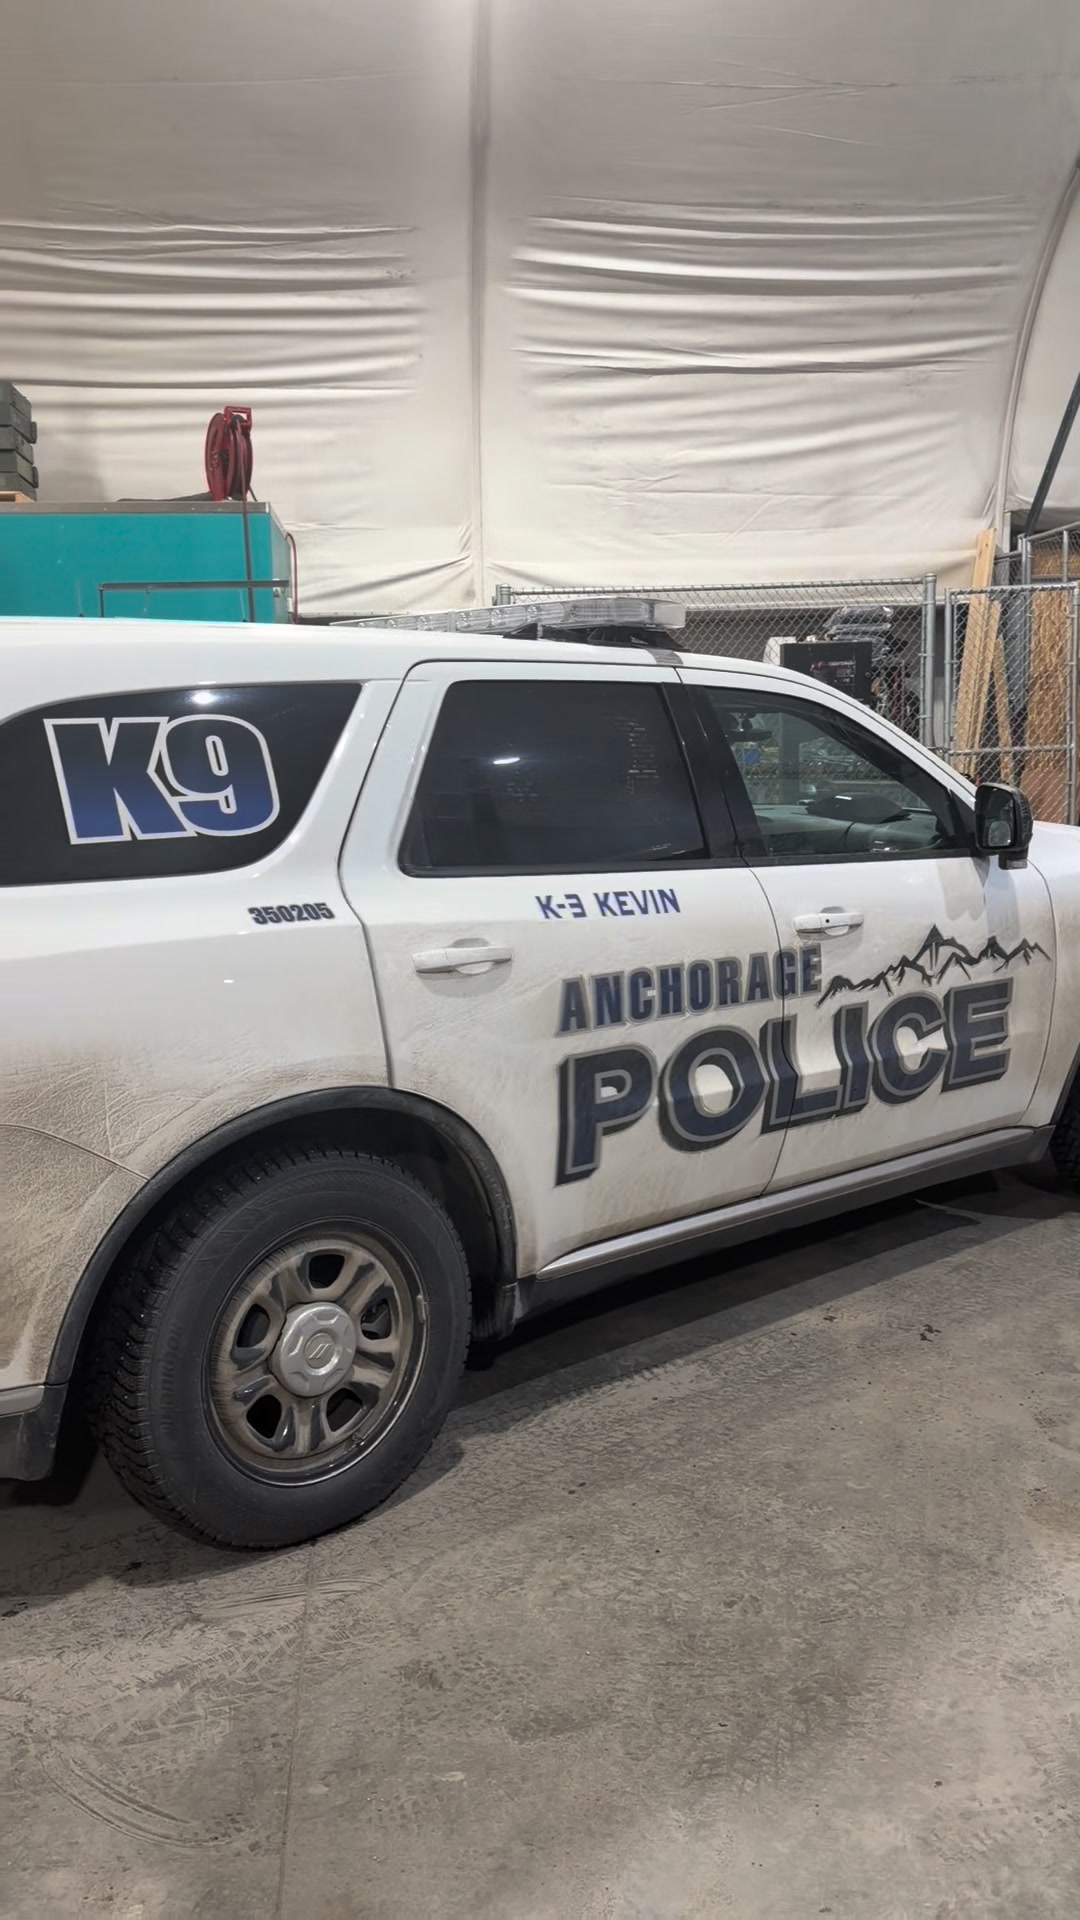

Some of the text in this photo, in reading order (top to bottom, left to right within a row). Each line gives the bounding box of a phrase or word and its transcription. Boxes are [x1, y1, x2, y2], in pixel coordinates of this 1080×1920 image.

[43, 714, 280, 845] K9
[248, 903, 335, 925] 350205
[535, 889, 681, 919] K-3 KEVIN
[555, 943, 823, 1037] ANCHORAGE
[555, 977, 1014, 1186] POLICE
